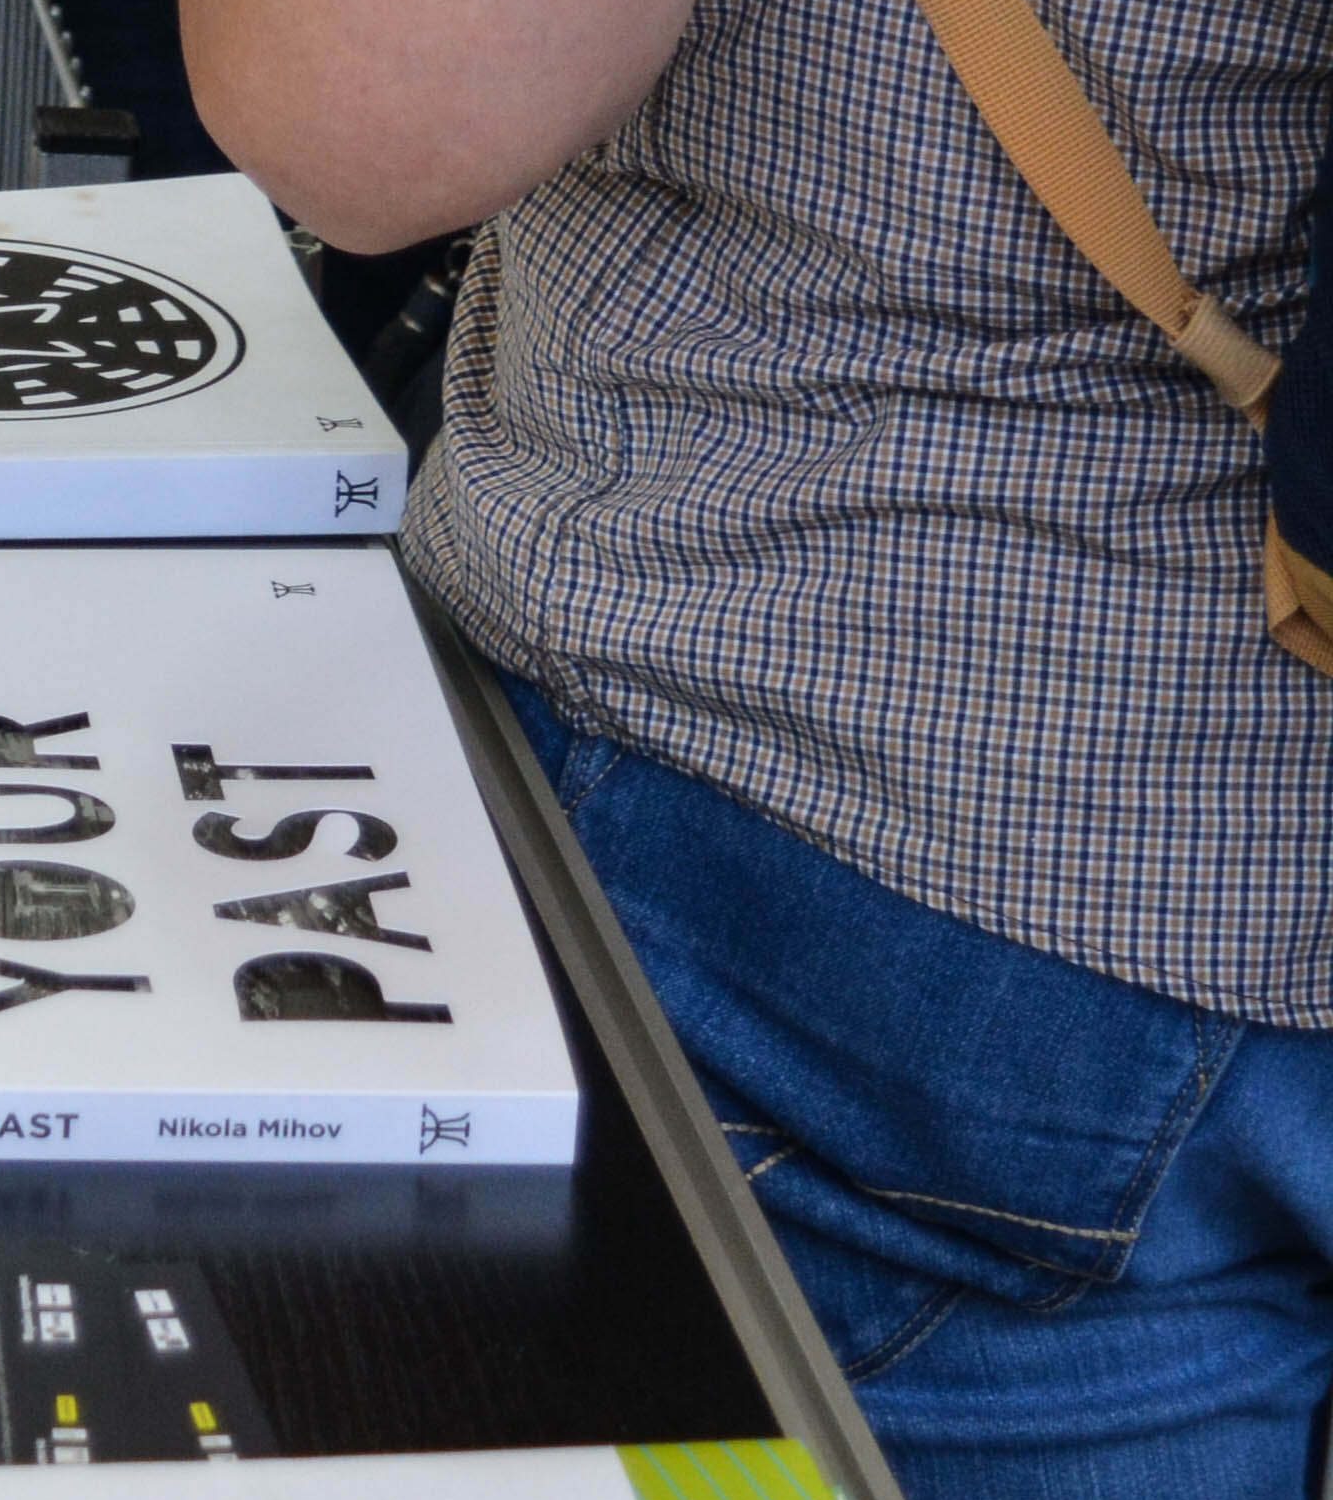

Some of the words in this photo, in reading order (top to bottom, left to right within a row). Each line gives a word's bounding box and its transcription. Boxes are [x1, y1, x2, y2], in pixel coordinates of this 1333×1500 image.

[170, 741, 455, 1024] PAST
[158, 1116, 249, 1140] Nikola
[256, 1116, 343, 1140] Mihov
